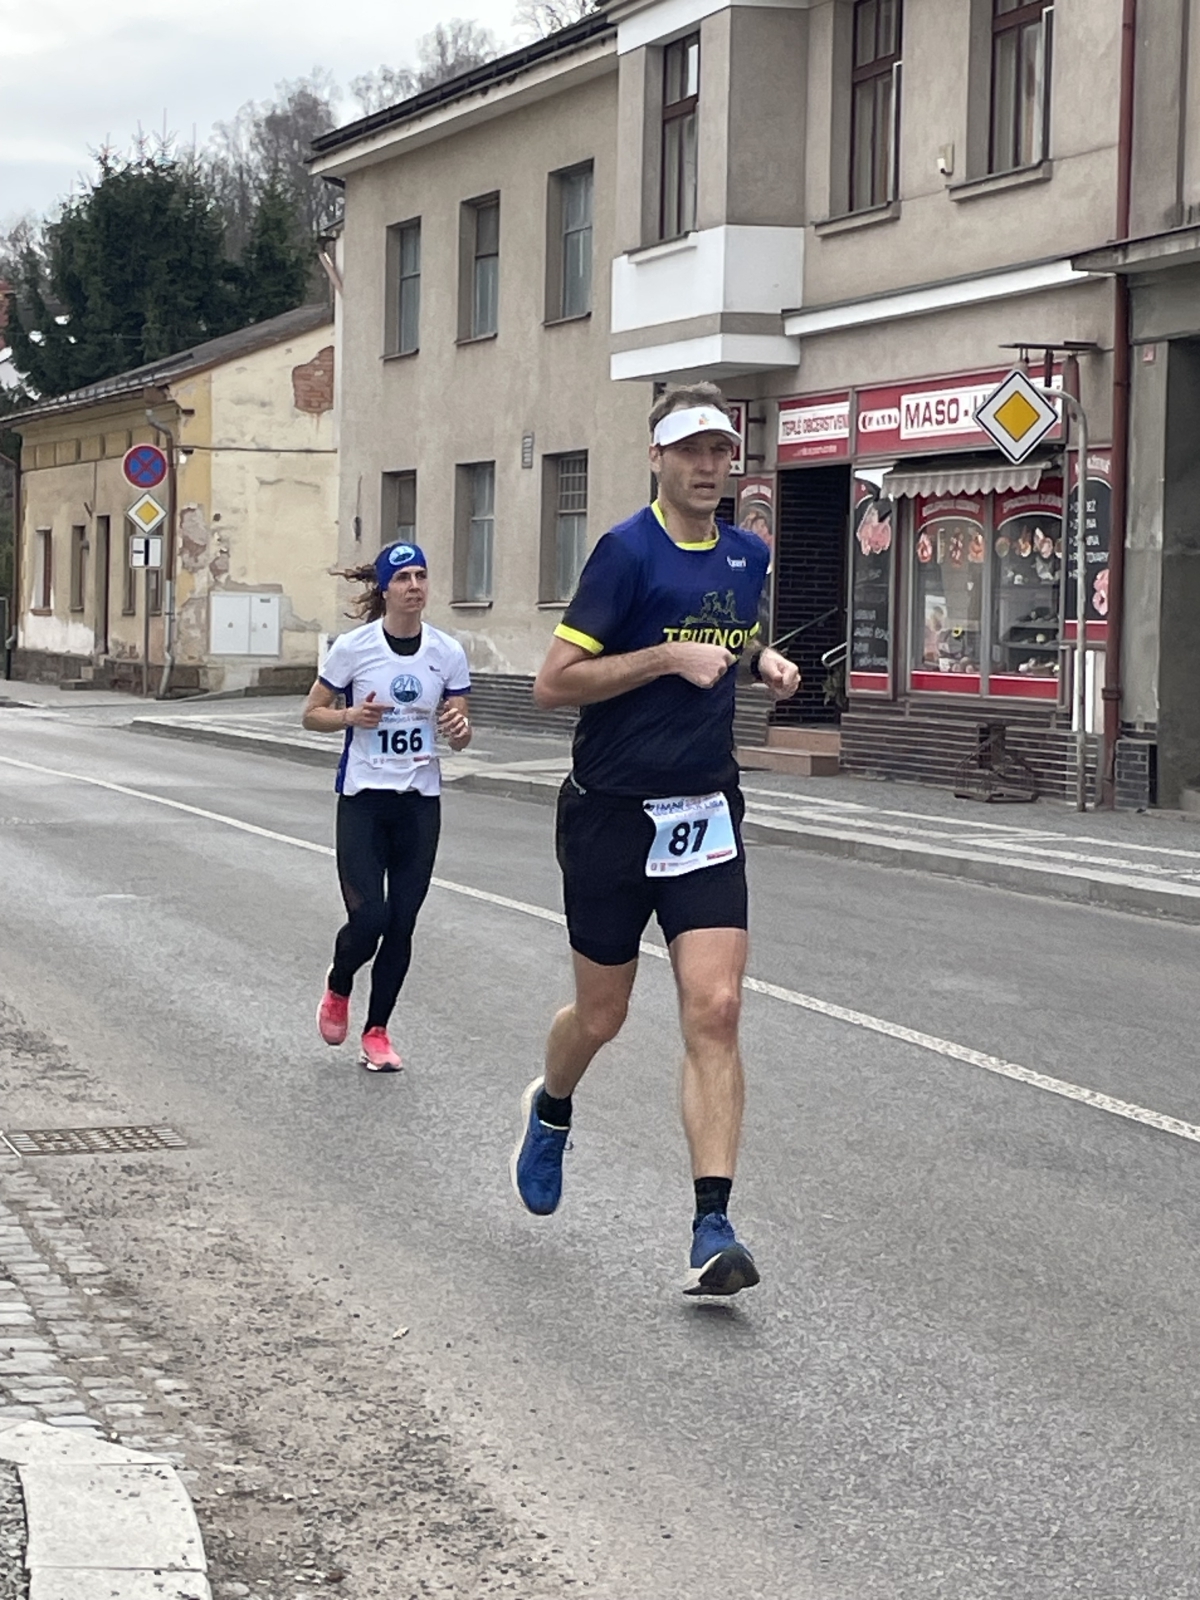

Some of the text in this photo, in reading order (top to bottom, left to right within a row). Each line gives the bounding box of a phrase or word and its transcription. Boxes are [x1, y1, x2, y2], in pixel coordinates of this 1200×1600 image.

[905, 397, 960, 430] MASO
[377, 727, 423, 754] 166
[668, 818, 709, 857] 87
